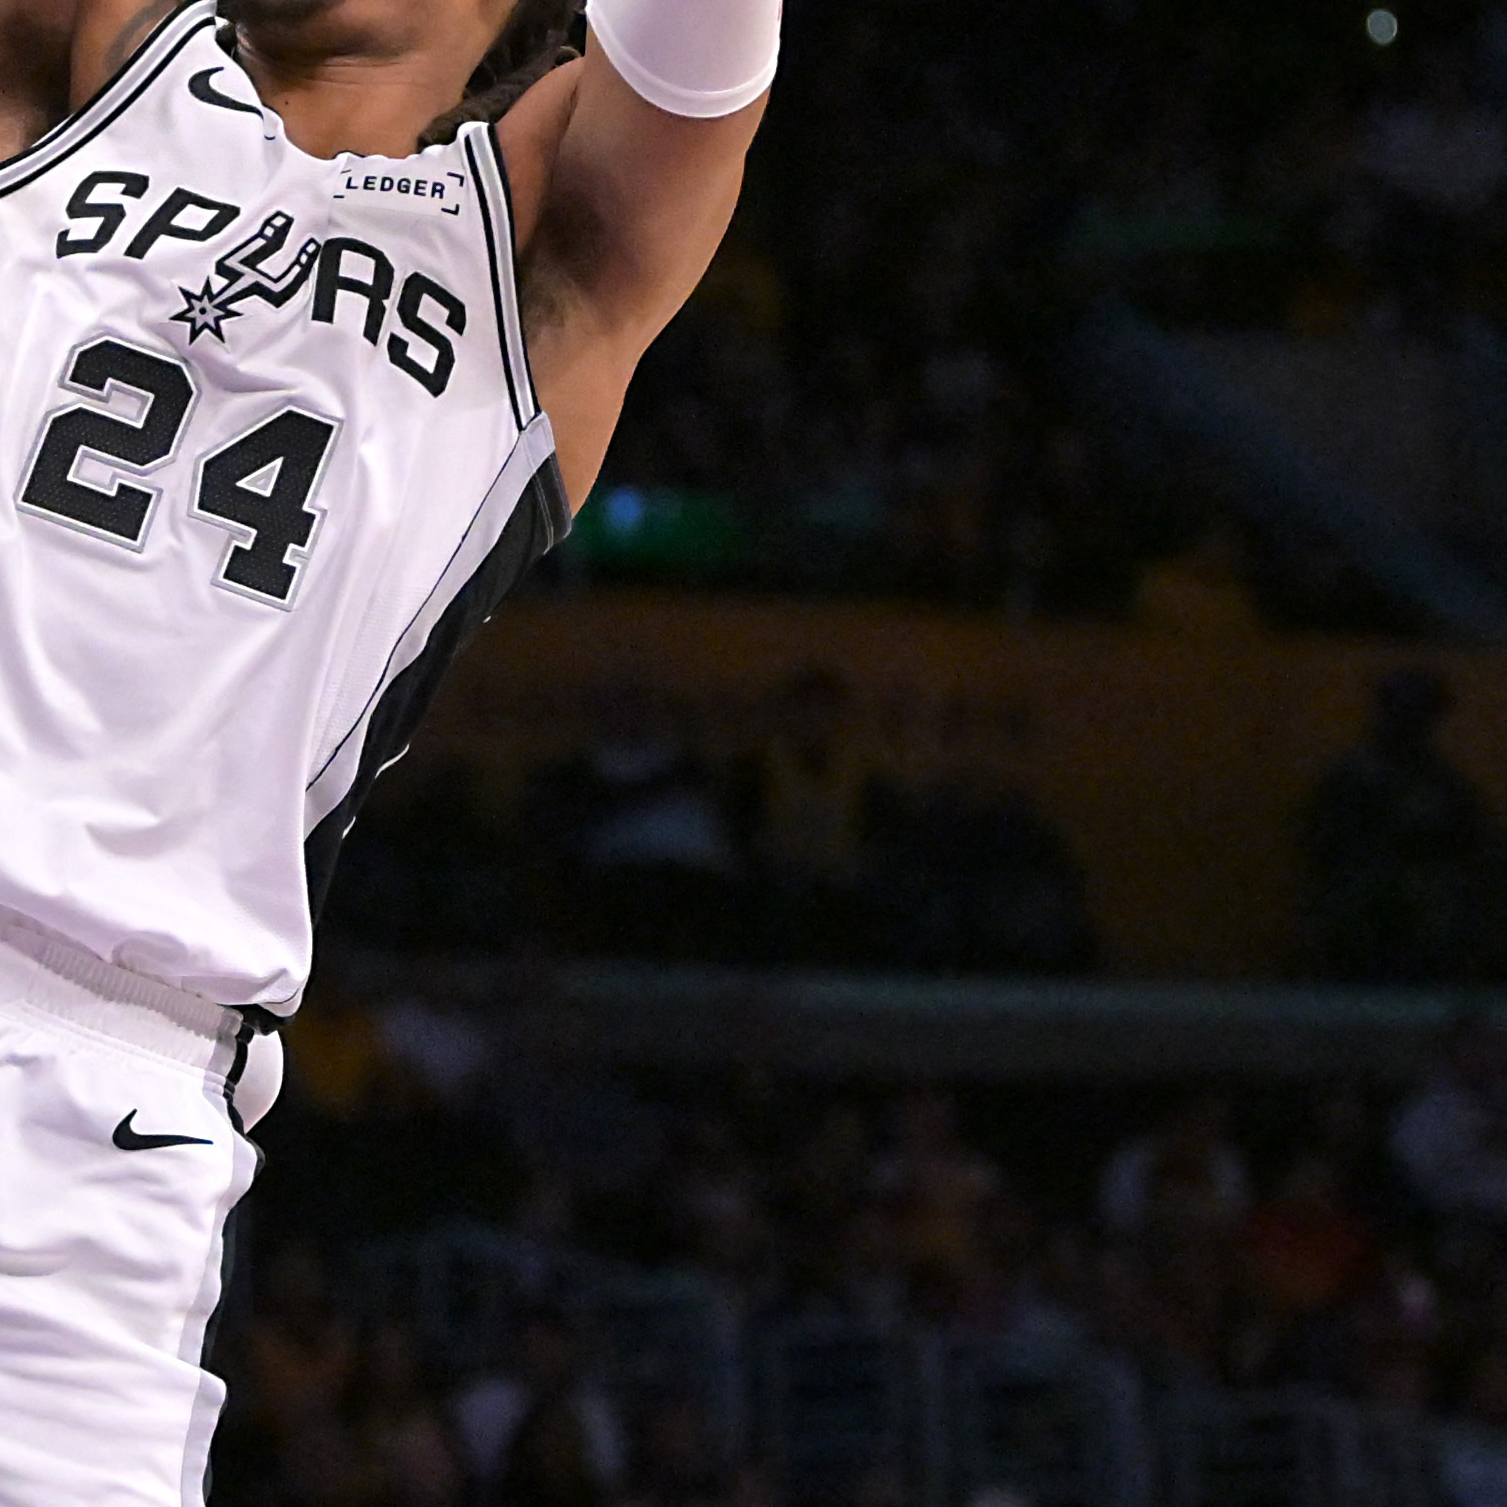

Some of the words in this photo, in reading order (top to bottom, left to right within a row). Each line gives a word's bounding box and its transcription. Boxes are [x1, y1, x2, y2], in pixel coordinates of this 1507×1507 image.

[55, 170, 467, 398] SPURS
[345, 175, 446, 199] LEDGER
[14, 331, 345, 613] 24
